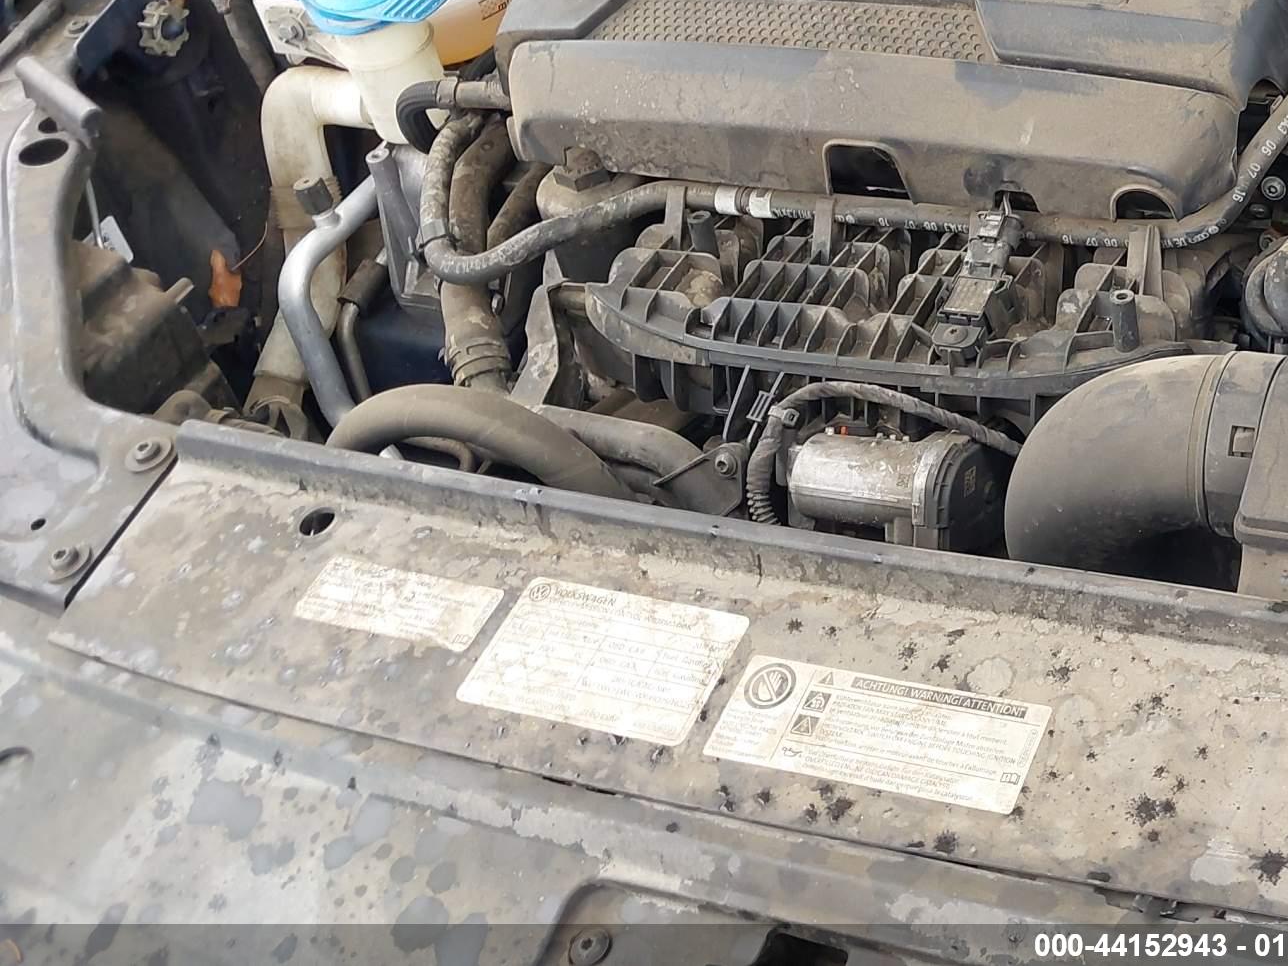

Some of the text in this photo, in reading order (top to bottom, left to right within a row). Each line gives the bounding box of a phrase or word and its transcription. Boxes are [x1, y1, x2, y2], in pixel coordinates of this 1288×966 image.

[1260, 139, 1277, 157] 06
[1245, 162, 1261, 179] 07
[855, 679, 1026, 717] ACHTUNG! WARNING! ATTENTION!
